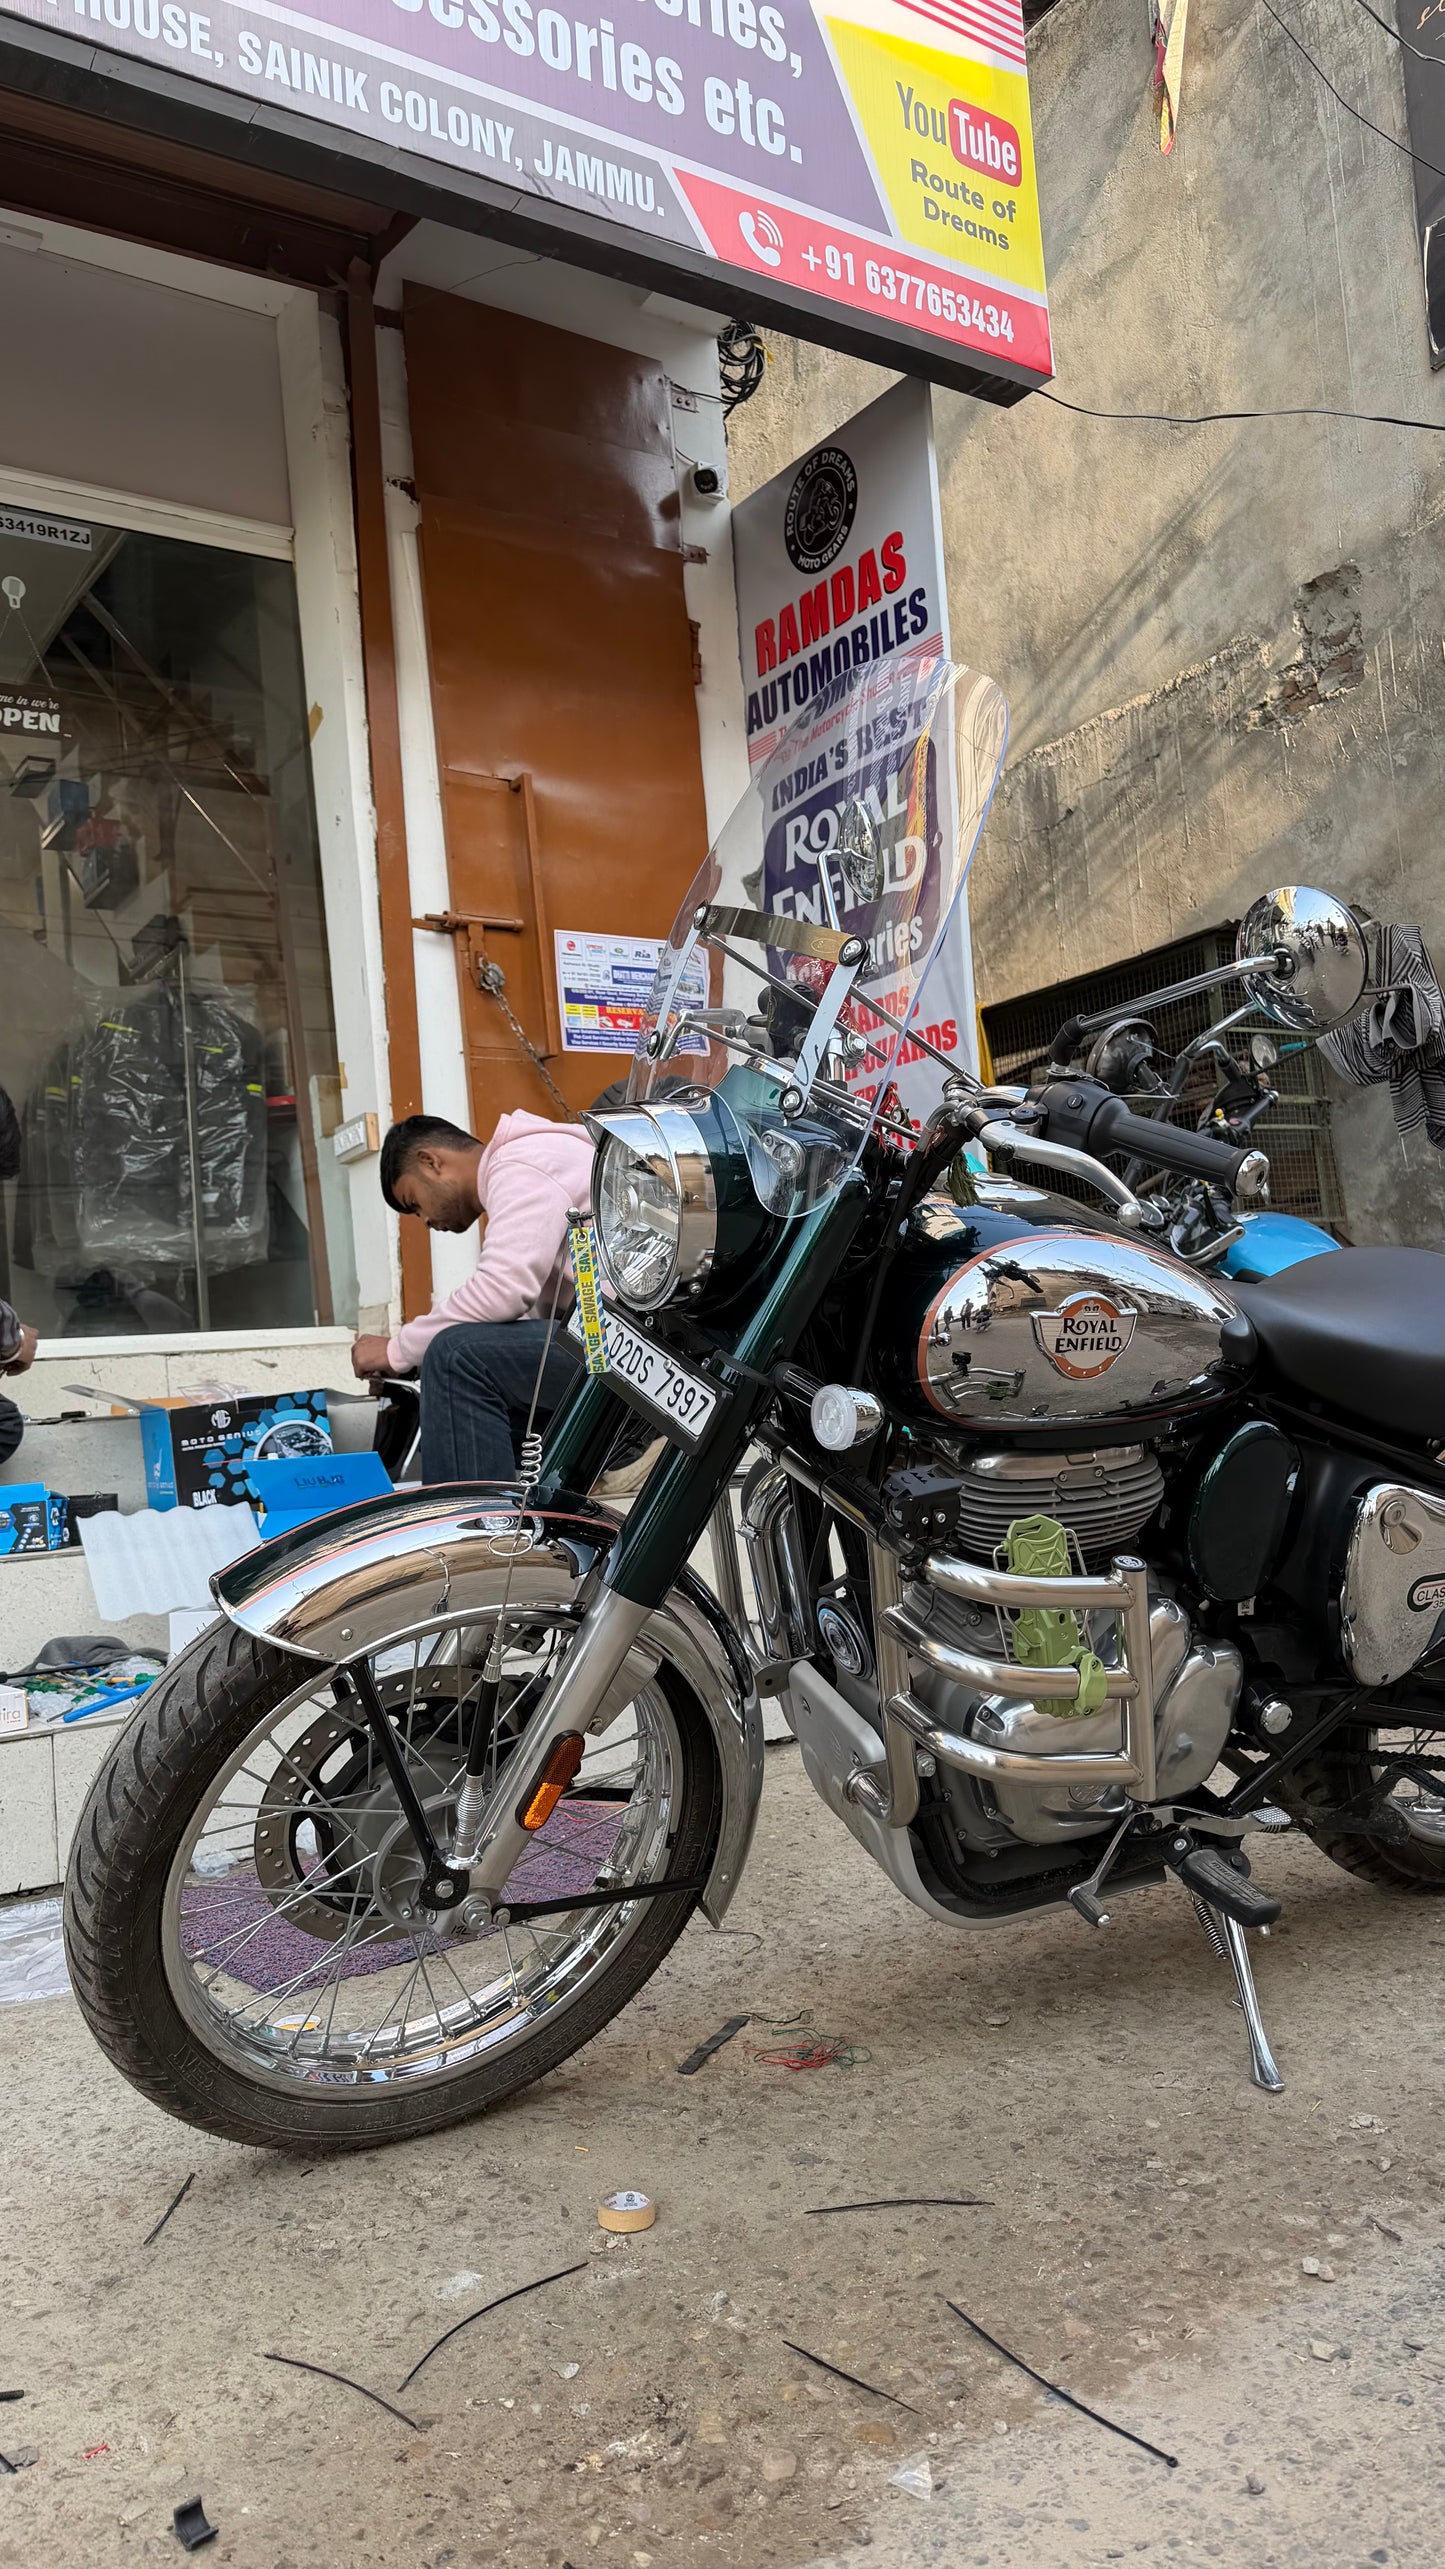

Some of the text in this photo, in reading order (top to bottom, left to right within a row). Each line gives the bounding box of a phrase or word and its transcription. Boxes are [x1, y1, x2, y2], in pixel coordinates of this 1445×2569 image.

[390, 0, 803, 163] essories etc.
[238, 30, 370, 114] SAINIK
[380, 80, 523, 172] COLONY,
[534, 139, 665, 217] JAMMU.
[910, 157, 1016, 223] Route of
[923, 196, 1010, 250] Dreams
[801, 244, 1015, 343] +91 6377653434
[786, 451, 855, 537] ROUTE OF DREAMS
[797, 524, 849, 569] MOTO GEARS
[755, 530, 907, 678] RAMDAS
[747, 587, 929, 737] AUTOMOBILES
[0, 707, 61, 734] PEN
[772, 738, 849, 812] INDIA'S
[582, 1280, 597, 1323] SAVAGE
[1063, 1317, 1118, 1336] ROYAL
[1055, 1336, 1122, 1353] ENFIELD
[654, 1368, 711, 1424] 7997
[192, 1488, 218, 1508] BLACK
